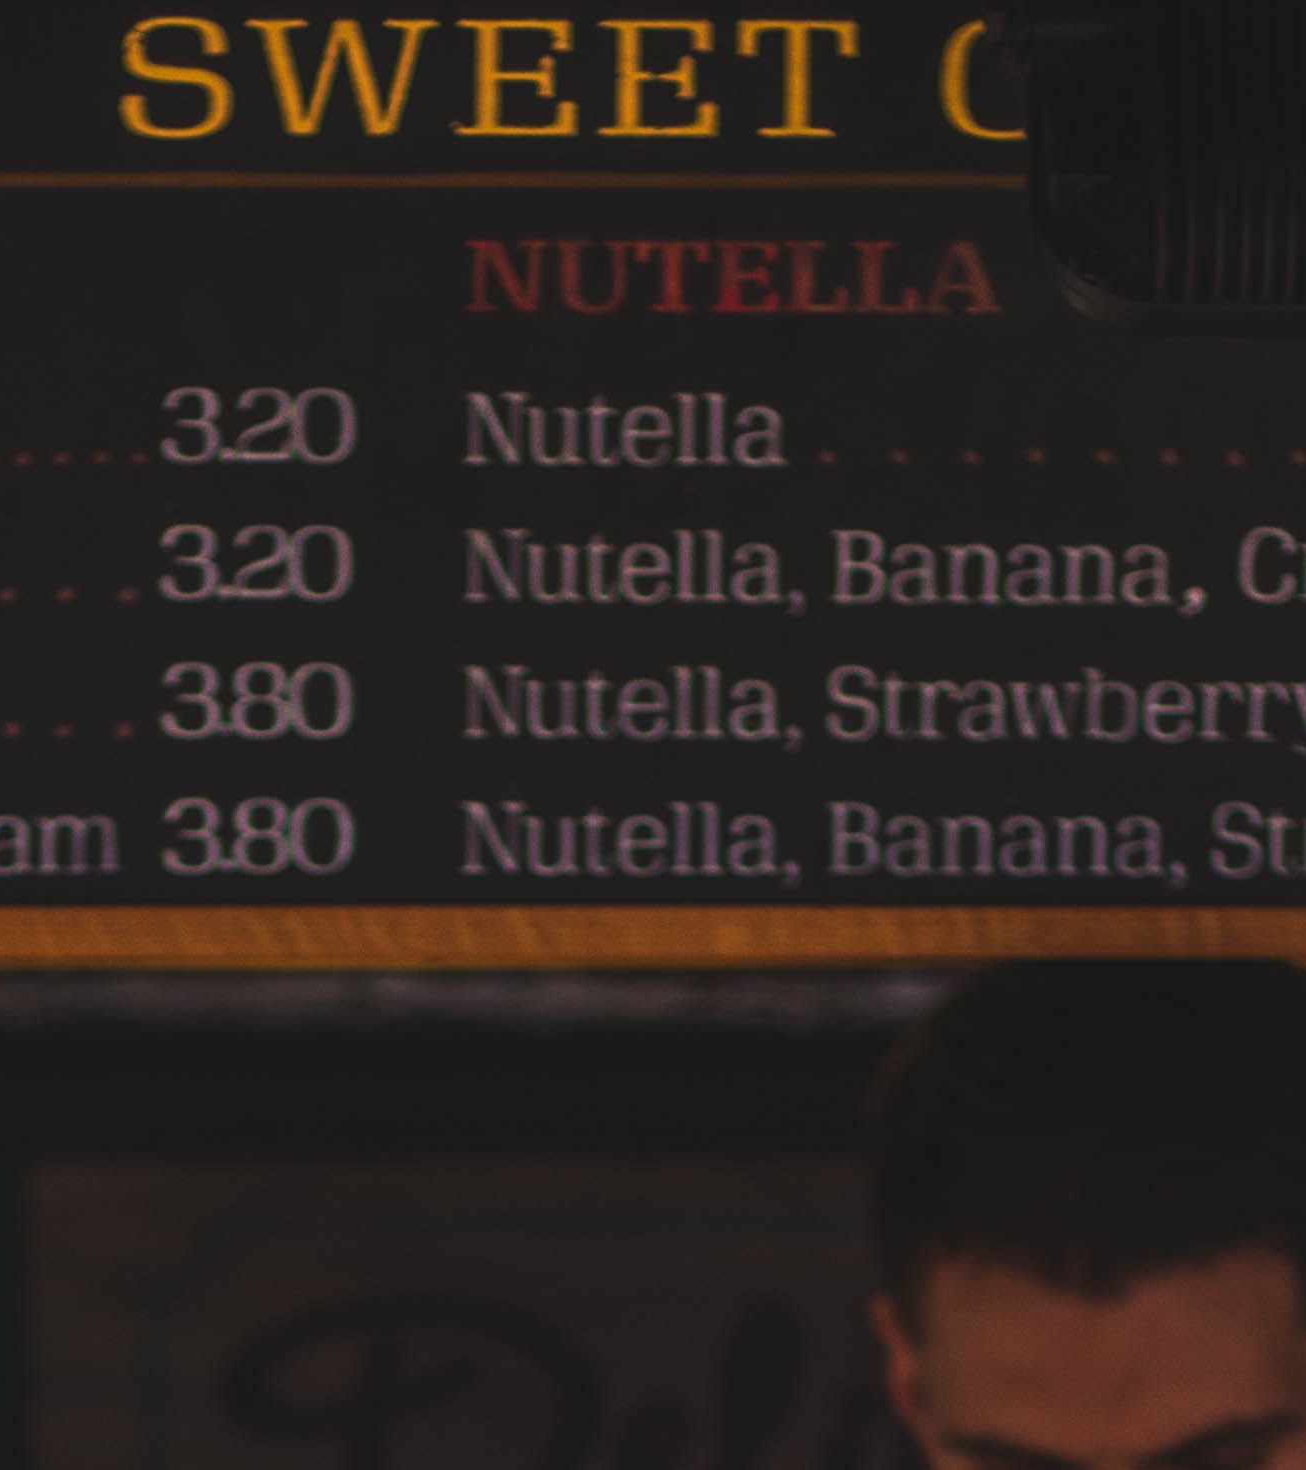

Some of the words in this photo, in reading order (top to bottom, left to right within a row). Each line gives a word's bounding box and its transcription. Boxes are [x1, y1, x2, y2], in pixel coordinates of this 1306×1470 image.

[119, 14, 858, 140] SWEET
[465, 238, 1001, 315] NUTELLA
[160, 385, 357, 465] 3.20
[463, 389, 787, 469] Nutella
[158, 522, 354, 602] 3.20
[464, 527, 806, 612] Nutella,
[832, 528, 1208, 616] Banana,
[159, 660, 353, 740] 3.80
[464, 663, 803, 752] Nutella,
[161, 795, 355, 875] 3.80
[460, 798, 801, 884] Nutella,
[828, 799, 1188, 887] Banana,
